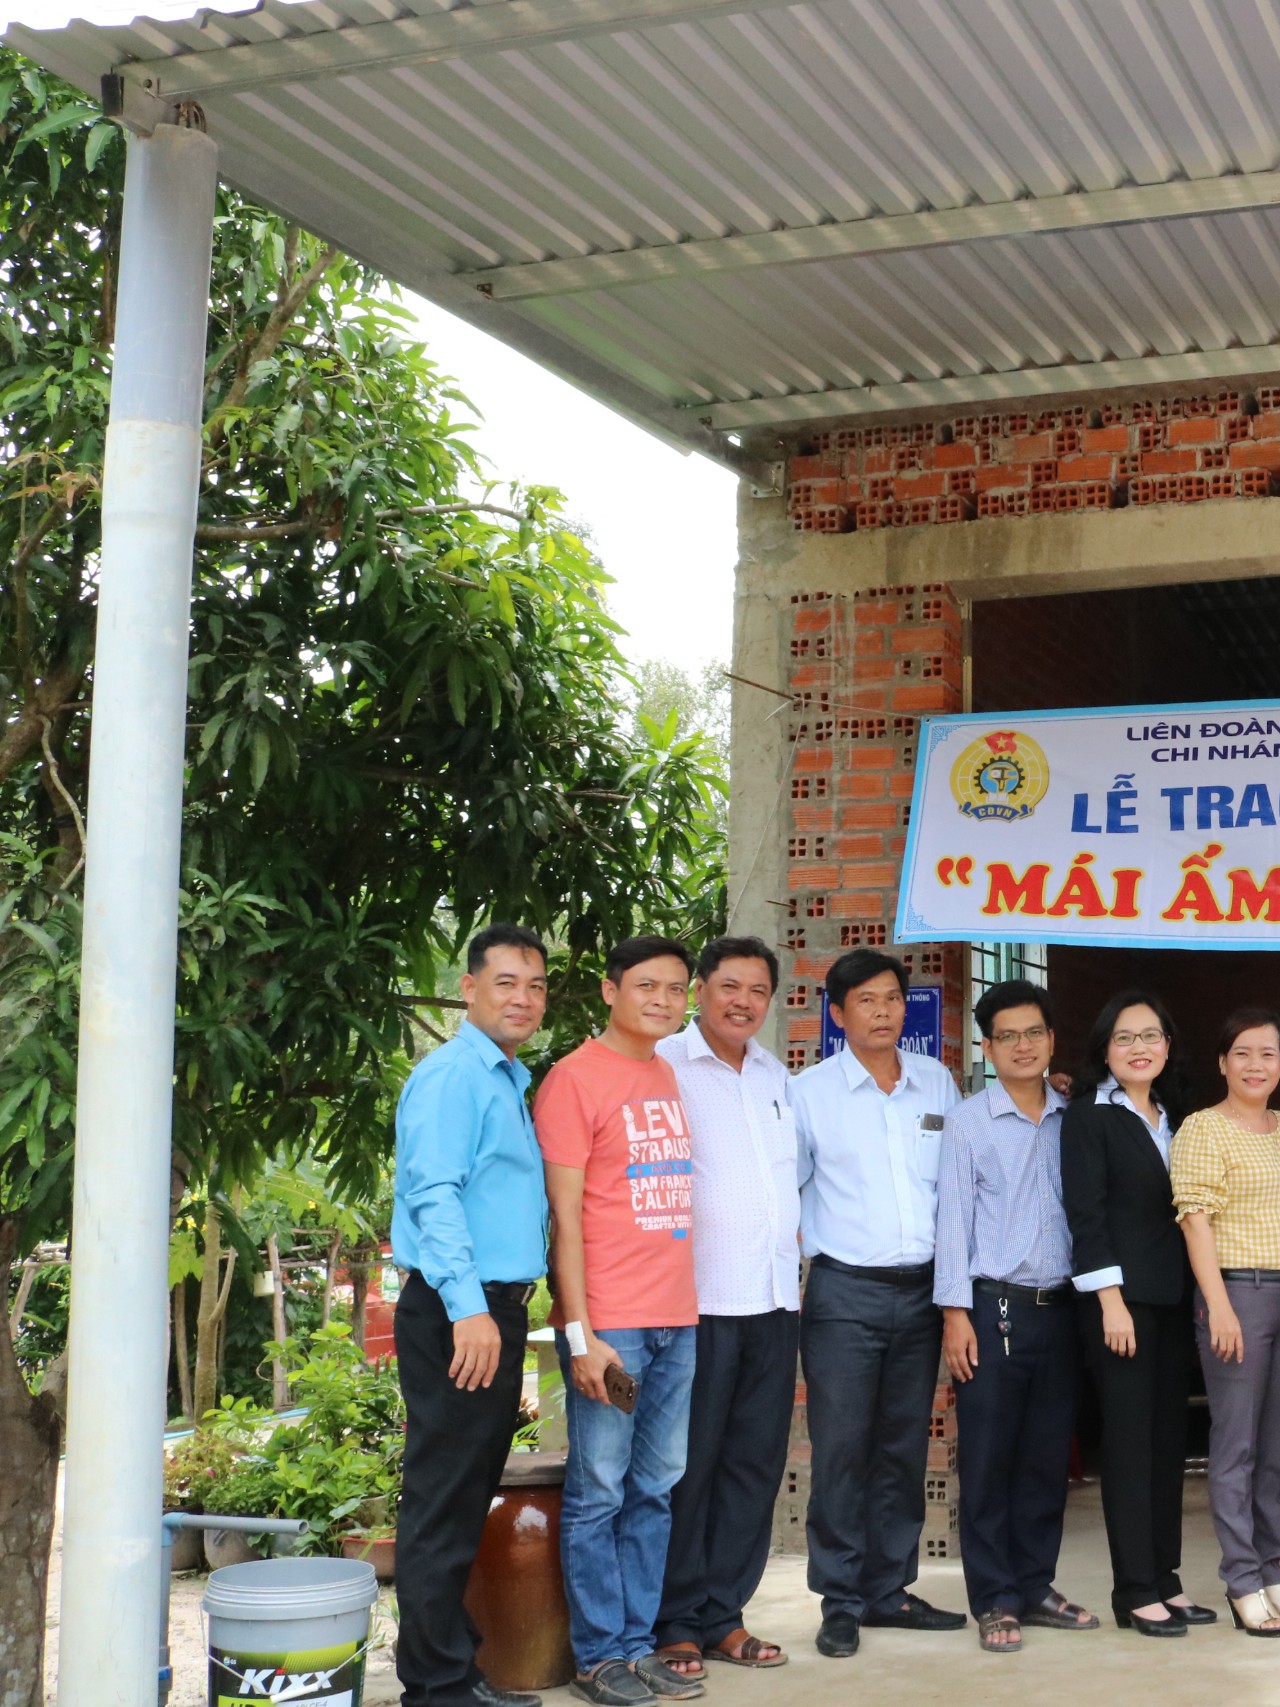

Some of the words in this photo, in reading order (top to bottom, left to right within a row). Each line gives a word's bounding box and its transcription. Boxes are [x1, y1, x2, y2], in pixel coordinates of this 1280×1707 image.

[1127, 722, 1191, 741] LIÊN
[1151, 746, 1199, 763] CHI
[1071, 773, 1139, 834] LỄ
[629, 1137, 692, 1164] STRAUS
[629, 1176, 659, 1194] SAN
[631, 1189, 692, 1212] CALIFOR
[634, 1215, 673, 1225] PREMIUM
[238, 1668, 337, 1695] Kixx
